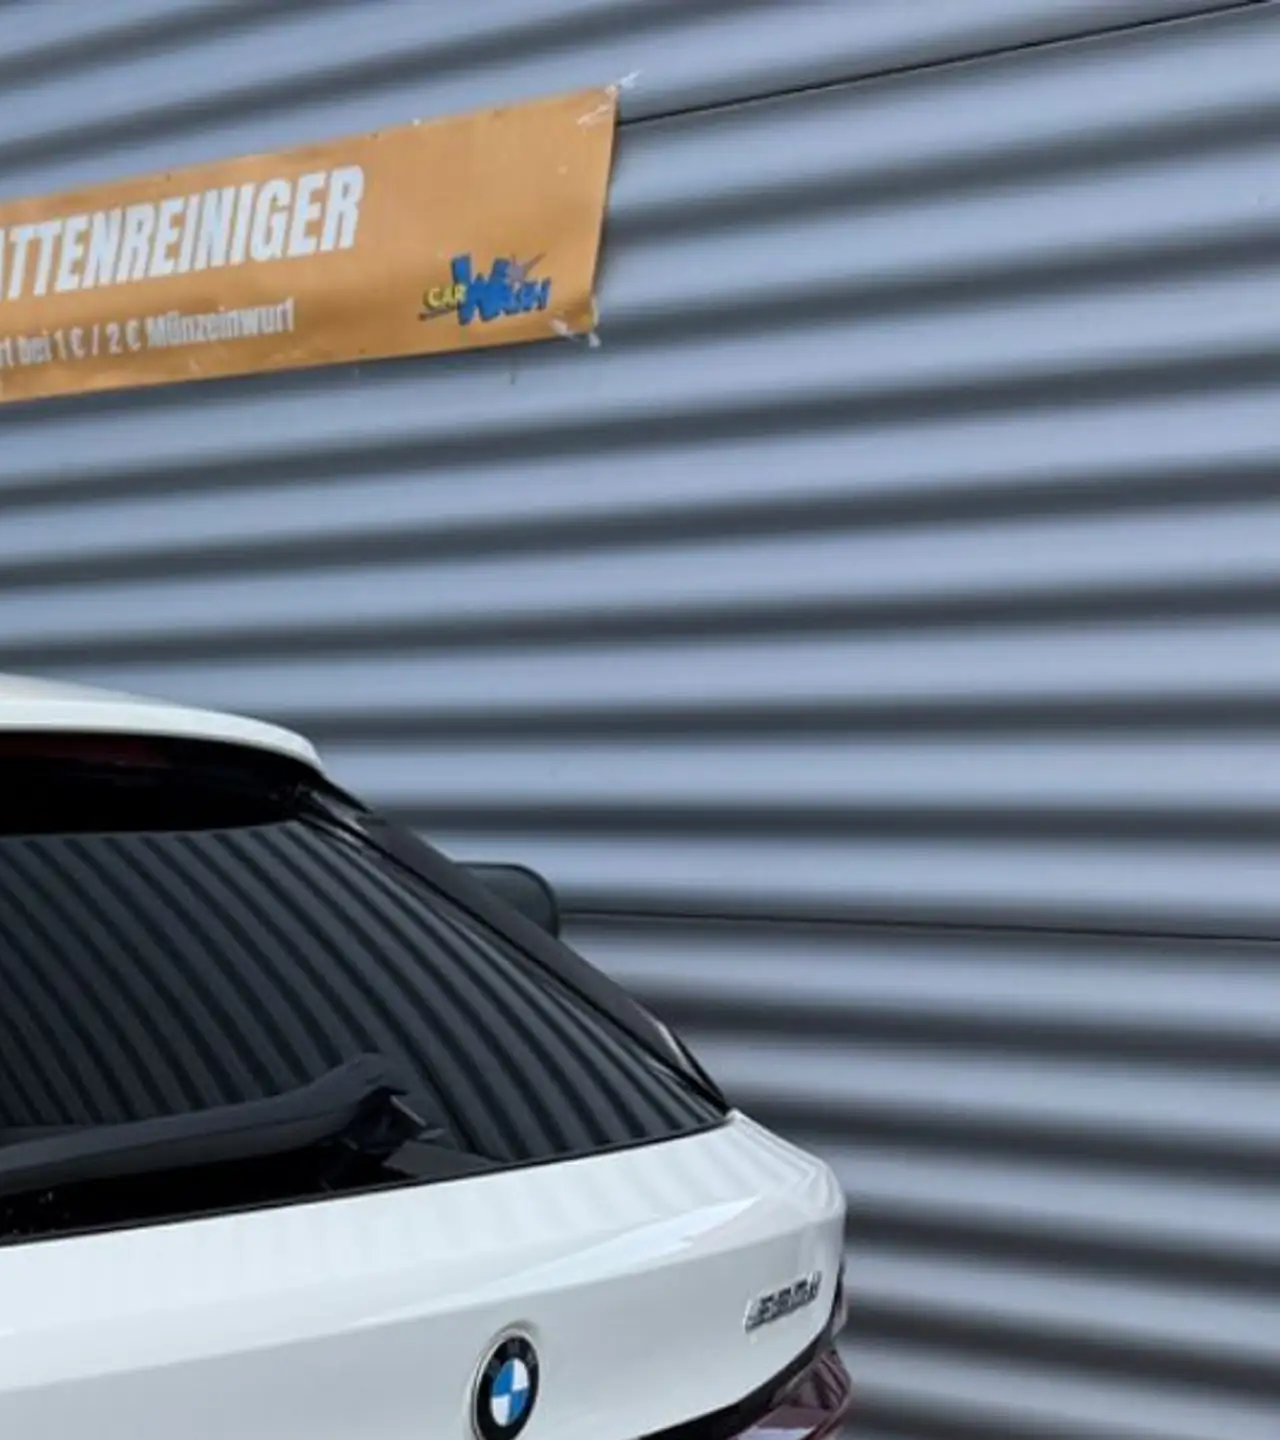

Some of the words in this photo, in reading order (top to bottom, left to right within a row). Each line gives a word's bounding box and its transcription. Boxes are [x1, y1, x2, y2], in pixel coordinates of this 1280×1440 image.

[17, 330, 52, 363] bei
[54, 329, 66, 361] 1
[105, 320, 122, 354] 2
[145, 297, 295, 348] Münzeinwurf
